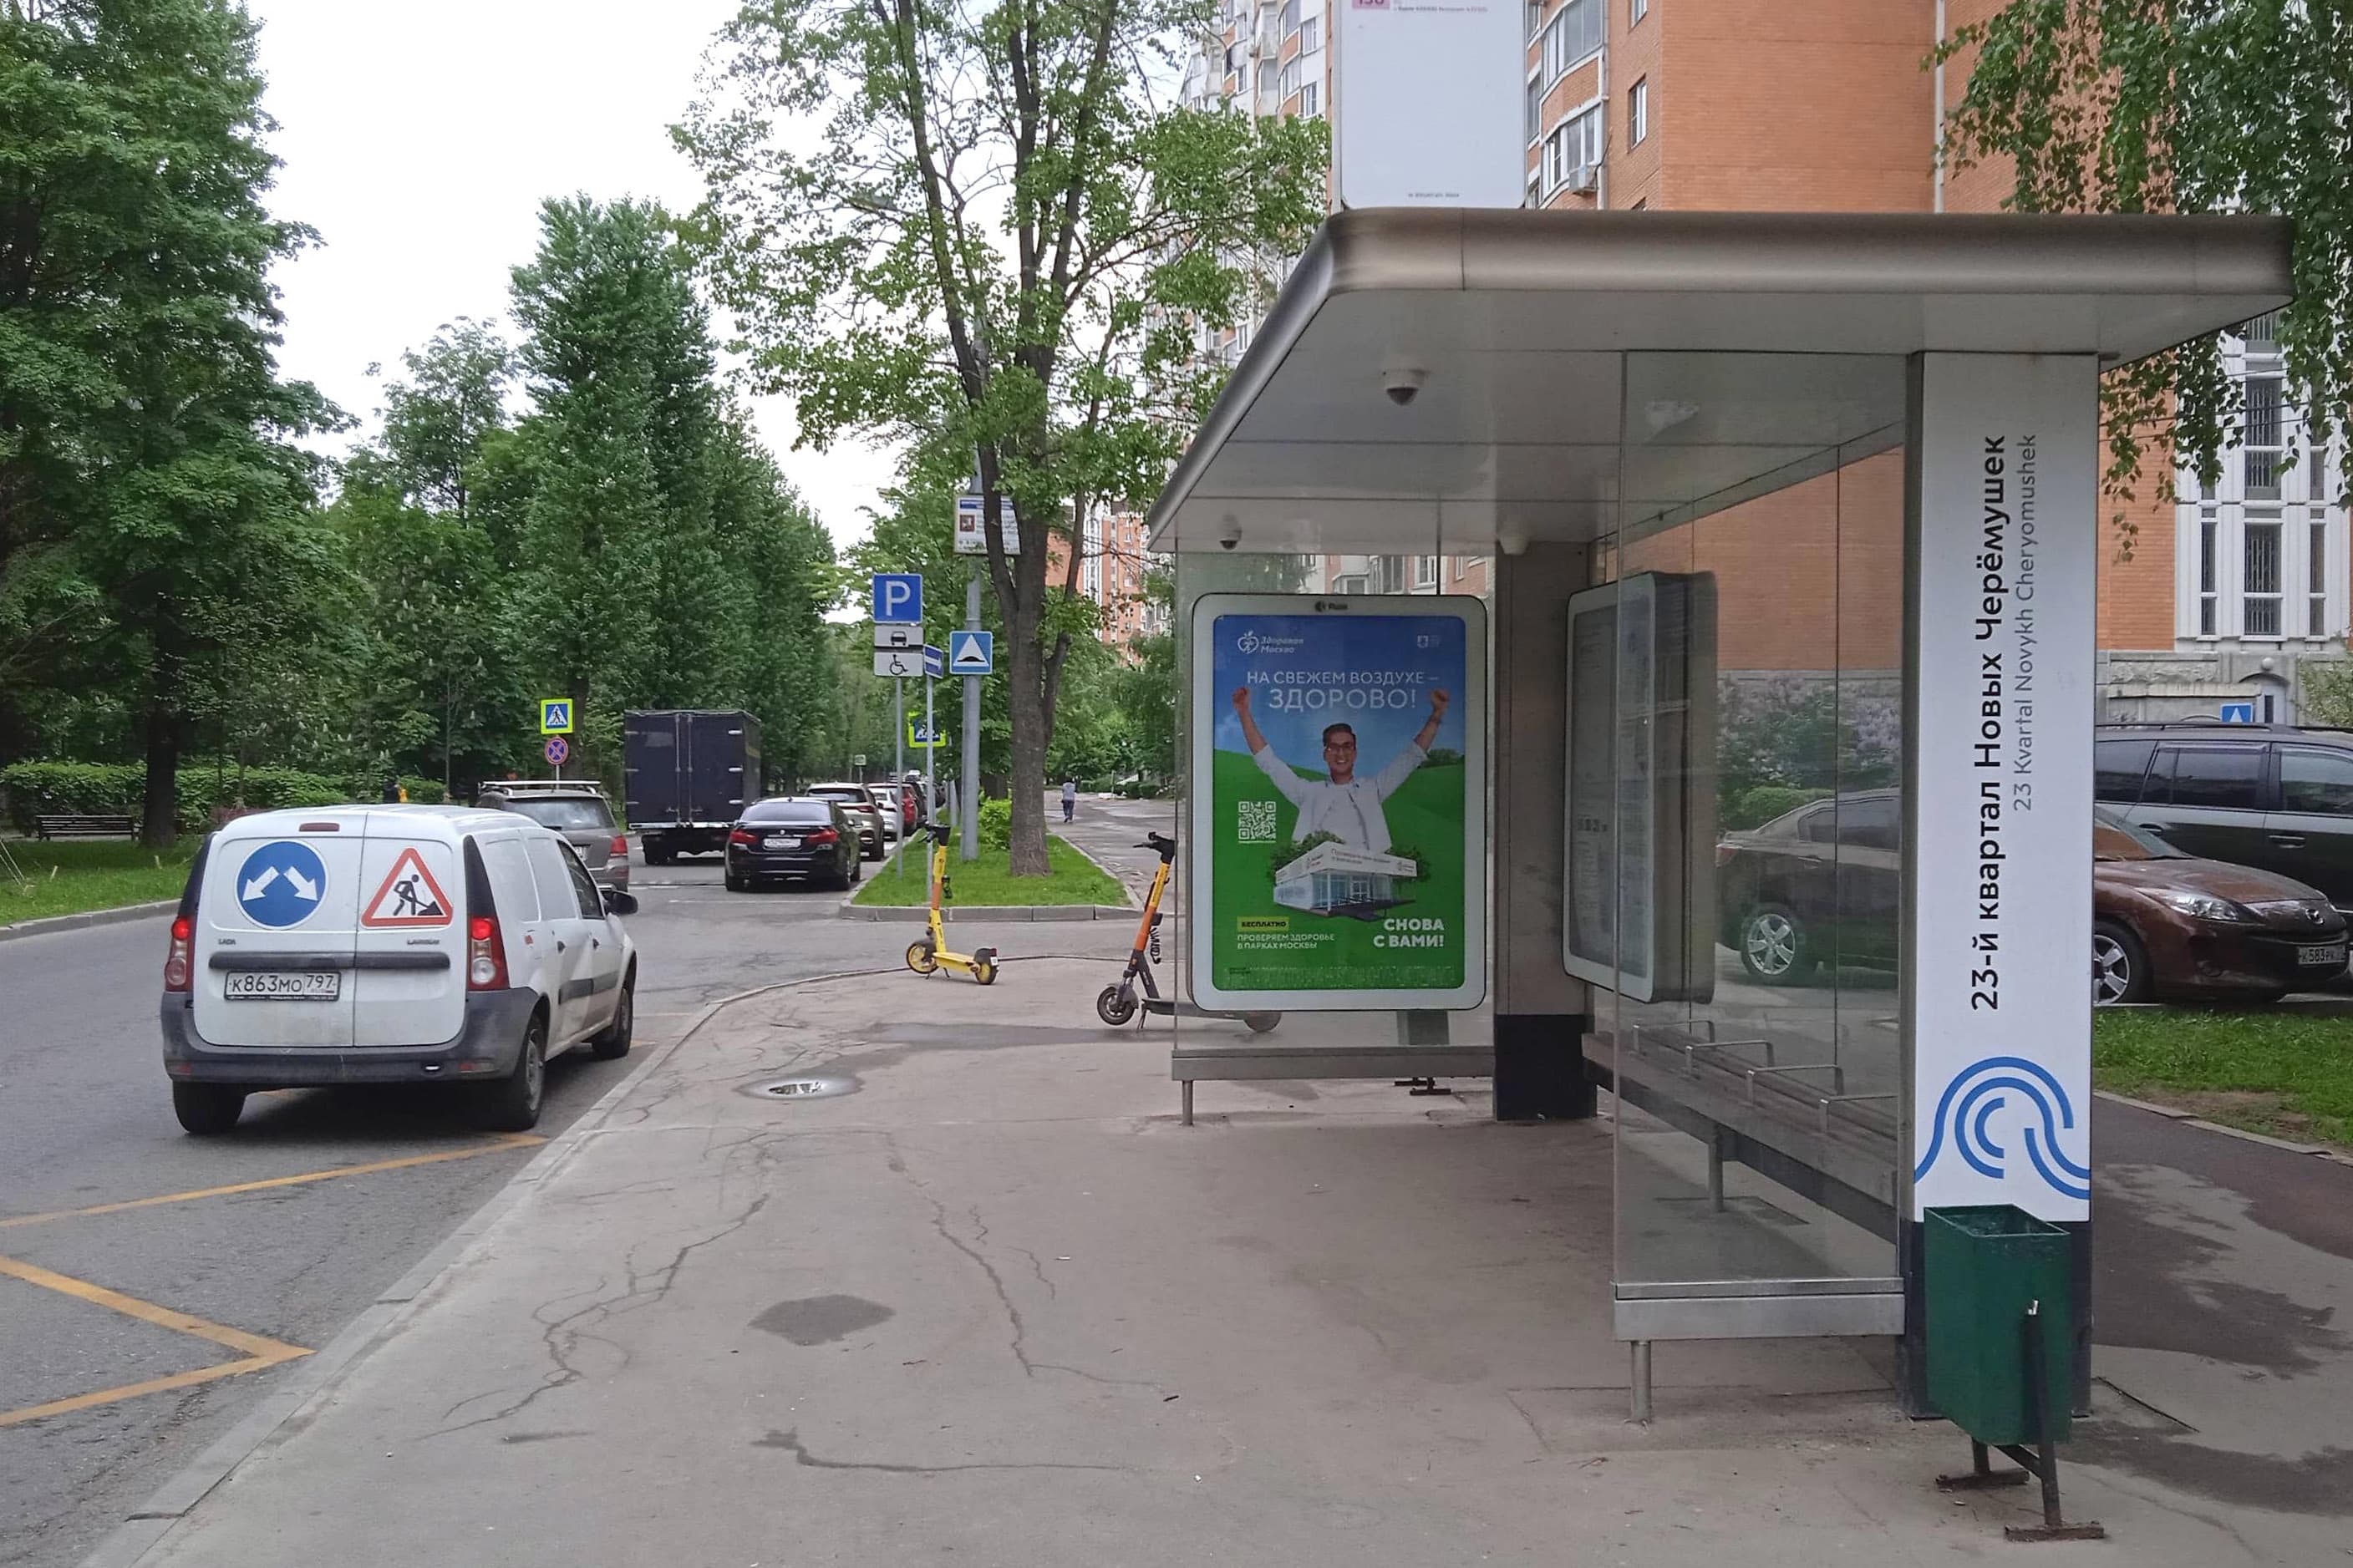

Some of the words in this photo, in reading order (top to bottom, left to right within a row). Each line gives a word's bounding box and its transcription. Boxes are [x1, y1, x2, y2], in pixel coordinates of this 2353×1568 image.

[2015, 434, 2039, 601] Cheryomushek
[1974, 434, 2011, 641] Черёмушек
[884, 581, 911, 617] P
[2014, 608, 2038, 692] Novykh
[1247, 671, 1270, 684] НА
[1273, 671, 1345, 684] СВЕЖЕМ
[1349, 671, 1425, 686] ВОЗДУХЕ
[1268, 688, 1416, 713] ЗДОРОВО!
[1974, 652, 2002, 767] Новых
[2013, 698, 2033, 774] Kvartal
[2013, 783, 2032, 811] 23
[1979, 781, 2007, 920] квартал
[1237, 933, 1288, 941] ПРОВЕРЯЕМ
[1290, 933, 1335, 942] ЗДОРОВЬЕ
[1384, 918, 1445, 931] СНОВА
[1243, 941, 1278, 950] ПАРКАХ
[1280, 941, 1318, 950] МОСКВЫ
[1373, 935, 1385, 948] С
[1388, 935, 1445, 948] ВАМИ!
[306, 975, 334, 989] 797
[1970, 932, 1999, 1011] 23-й
